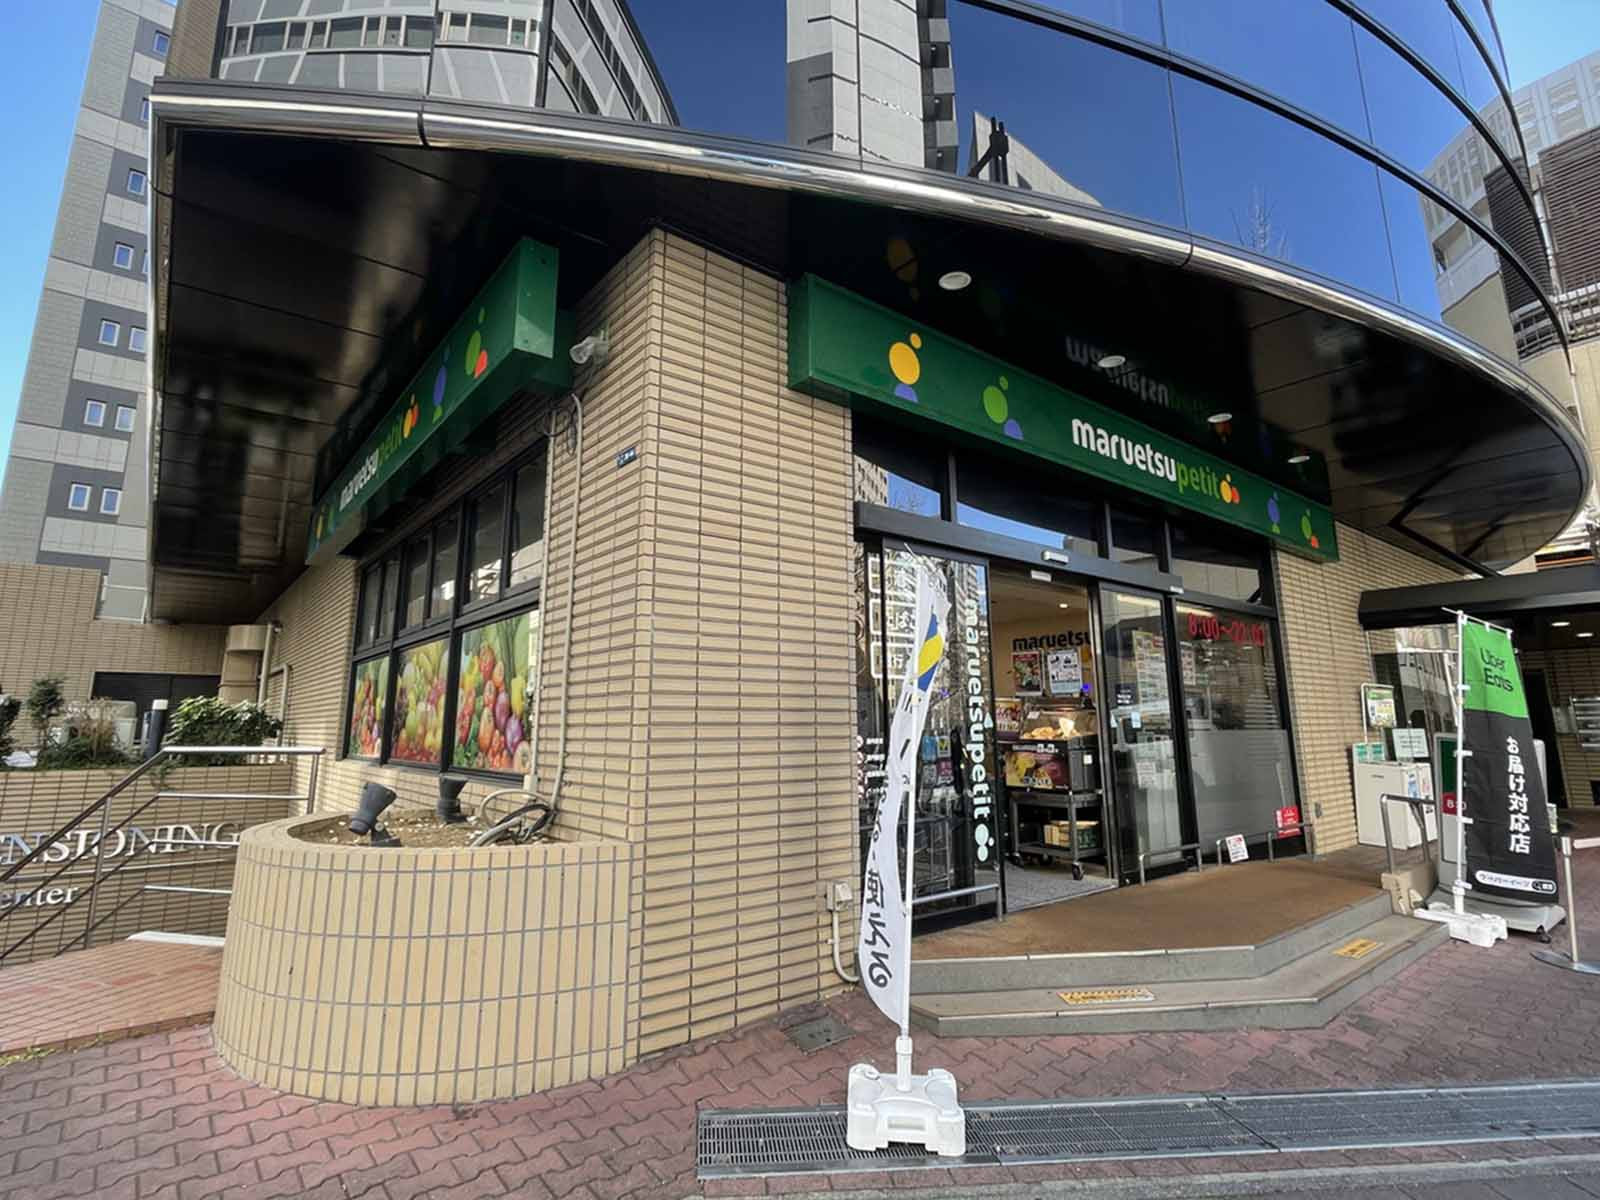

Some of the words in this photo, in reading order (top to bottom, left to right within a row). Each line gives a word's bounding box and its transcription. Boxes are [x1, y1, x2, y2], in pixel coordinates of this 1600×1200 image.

[1506, 736, 1531, 855] お届け対応店
